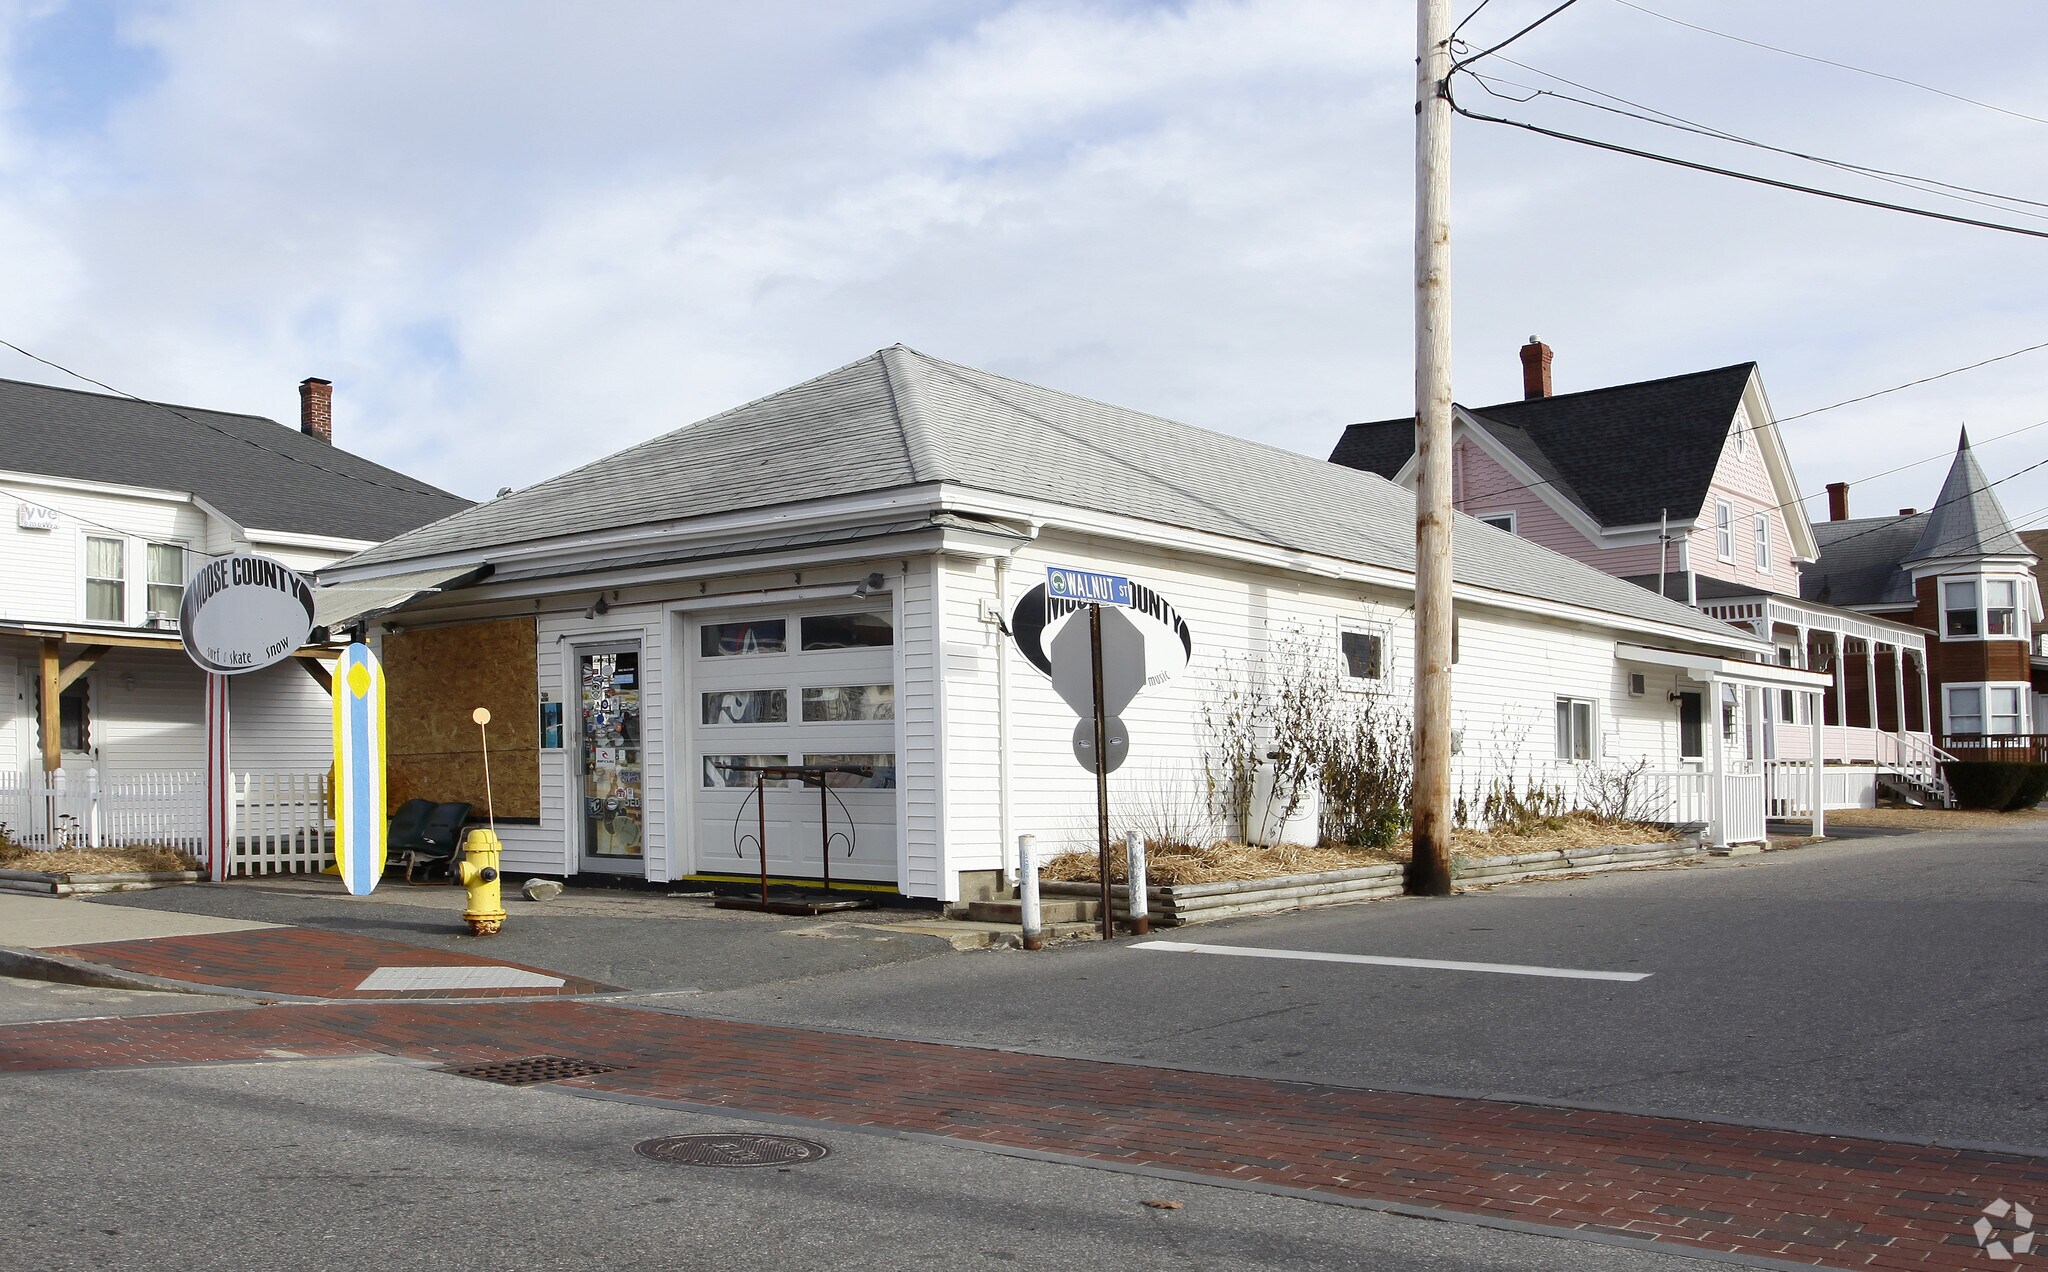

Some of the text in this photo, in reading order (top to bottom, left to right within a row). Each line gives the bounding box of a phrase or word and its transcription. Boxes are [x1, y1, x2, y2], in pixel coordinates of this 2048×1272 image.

[192, 557, 301, 617] MOOSE COUNTY
[1066, 572, 1128, 600] WALNUT ST
[1127, 580, 1183, 635] OUNTY
[207, 636, 289, 665] surf skate snow
[1147, 670, 1171, 687] music
